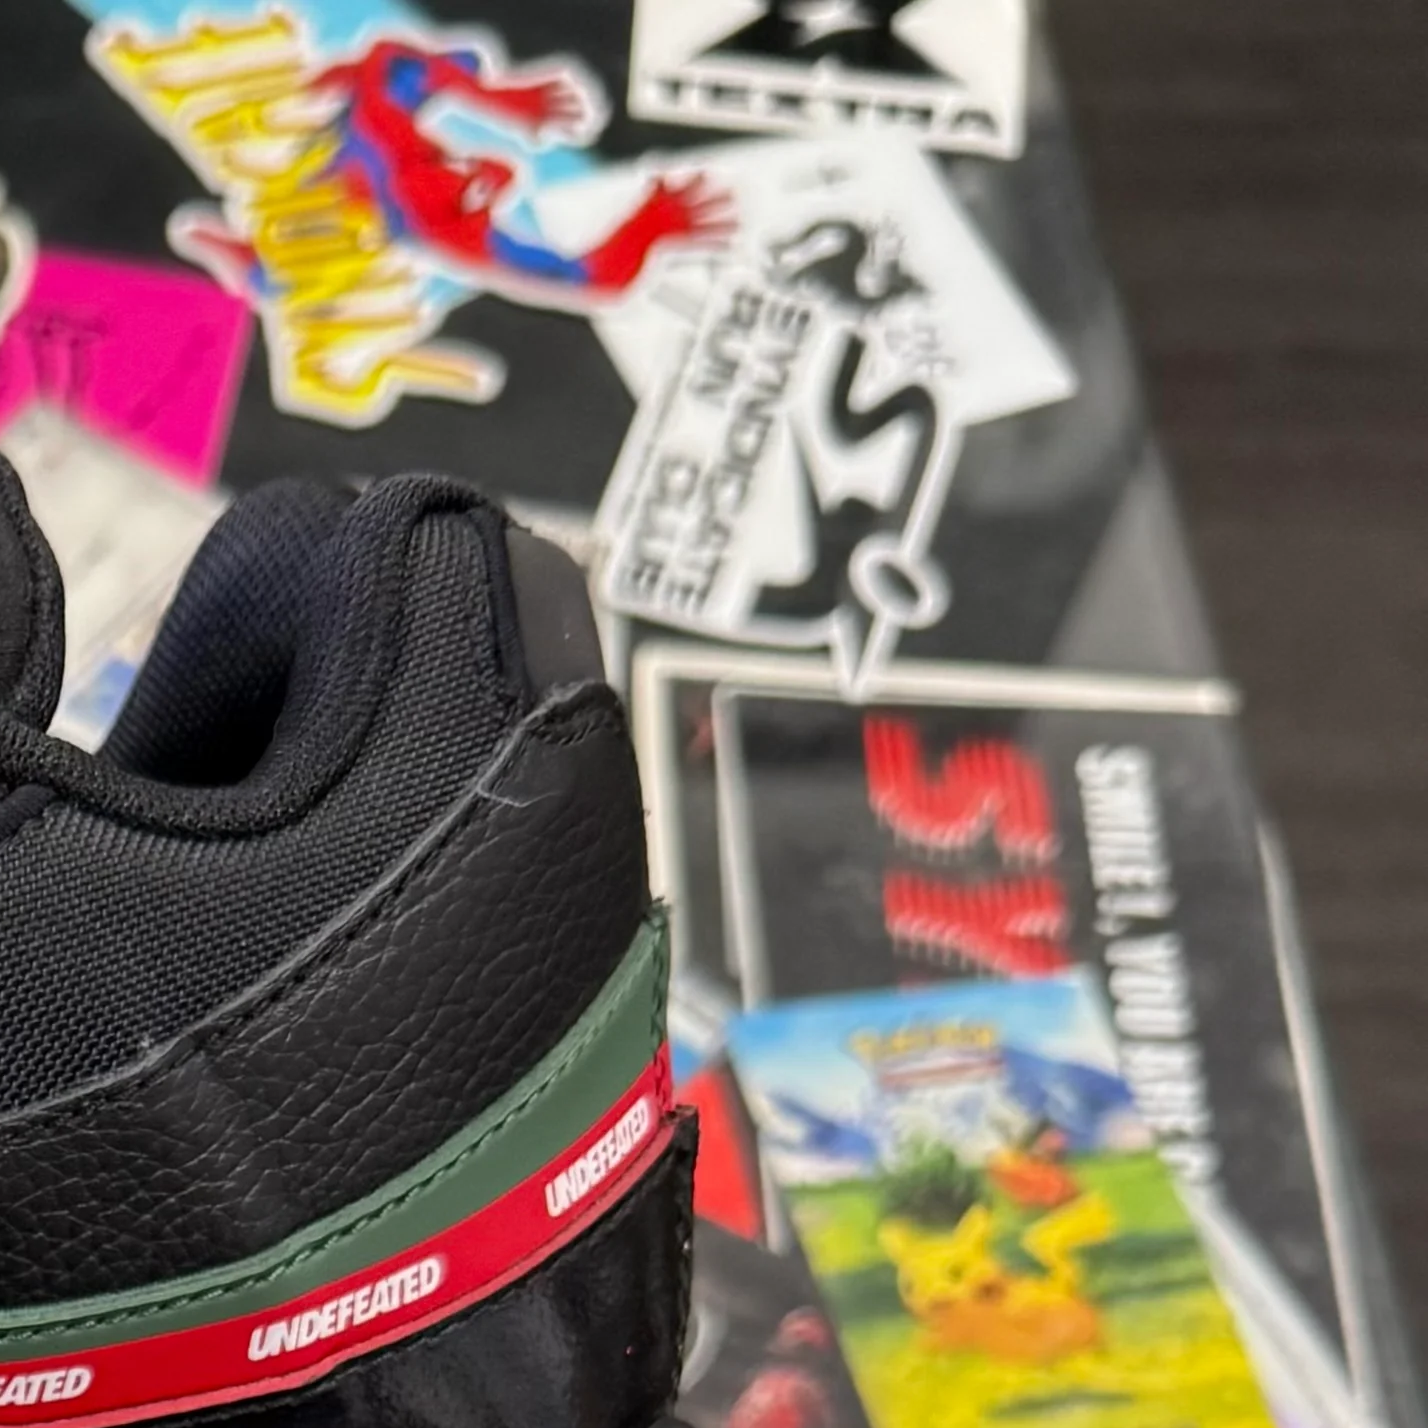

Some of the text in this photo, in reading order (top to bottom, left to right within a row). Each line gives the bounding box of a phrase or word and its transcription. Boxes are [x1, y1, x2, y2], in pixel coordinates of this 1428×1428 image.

[688, 288, 765, 402] RUN
[660, 298, 812, 616] SYNDICATE
[622, 455, 702, 600] CLUB
[247, 1255, 445, 1362] UNDEFEATED
